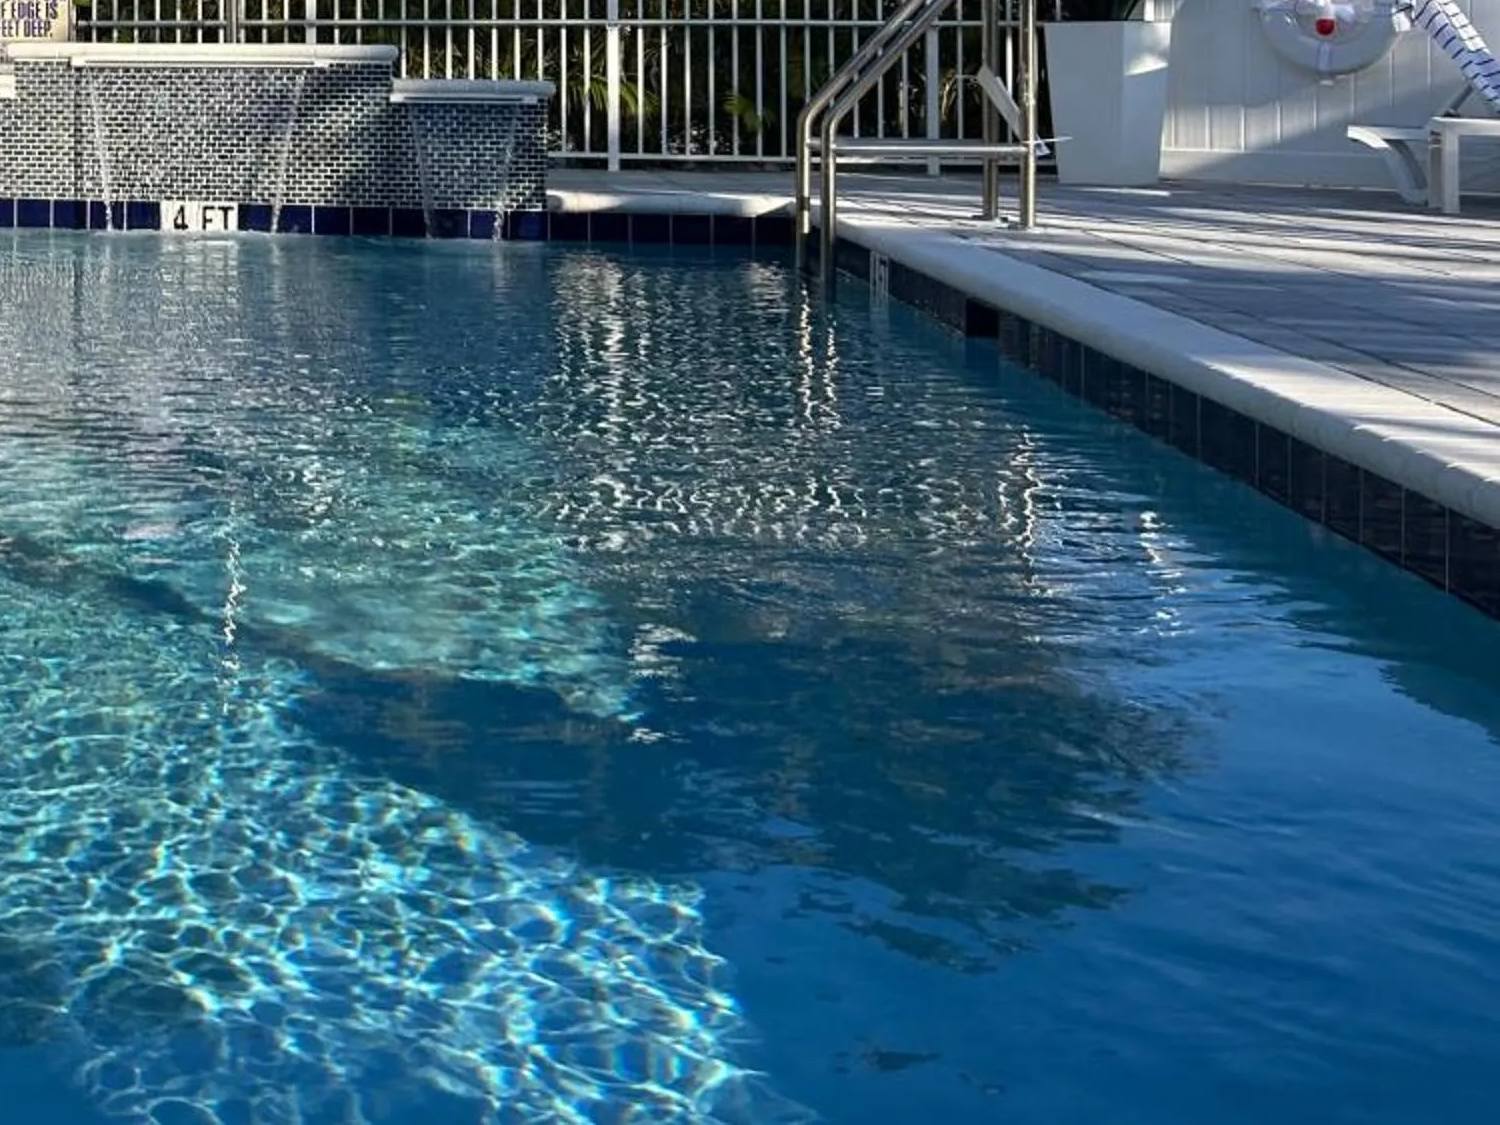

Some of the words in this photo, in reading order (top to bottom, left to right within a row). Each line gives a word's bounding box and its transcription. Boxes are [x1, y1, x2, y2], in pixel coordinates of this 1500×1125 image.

[10, 2, 41, 19] EDGE
[45, 2, 59, 19] IS
[23, 20, 53, 37] DEEP.
[173, 204, 189, 230] 4
[202, 205, 235, 230] FT
